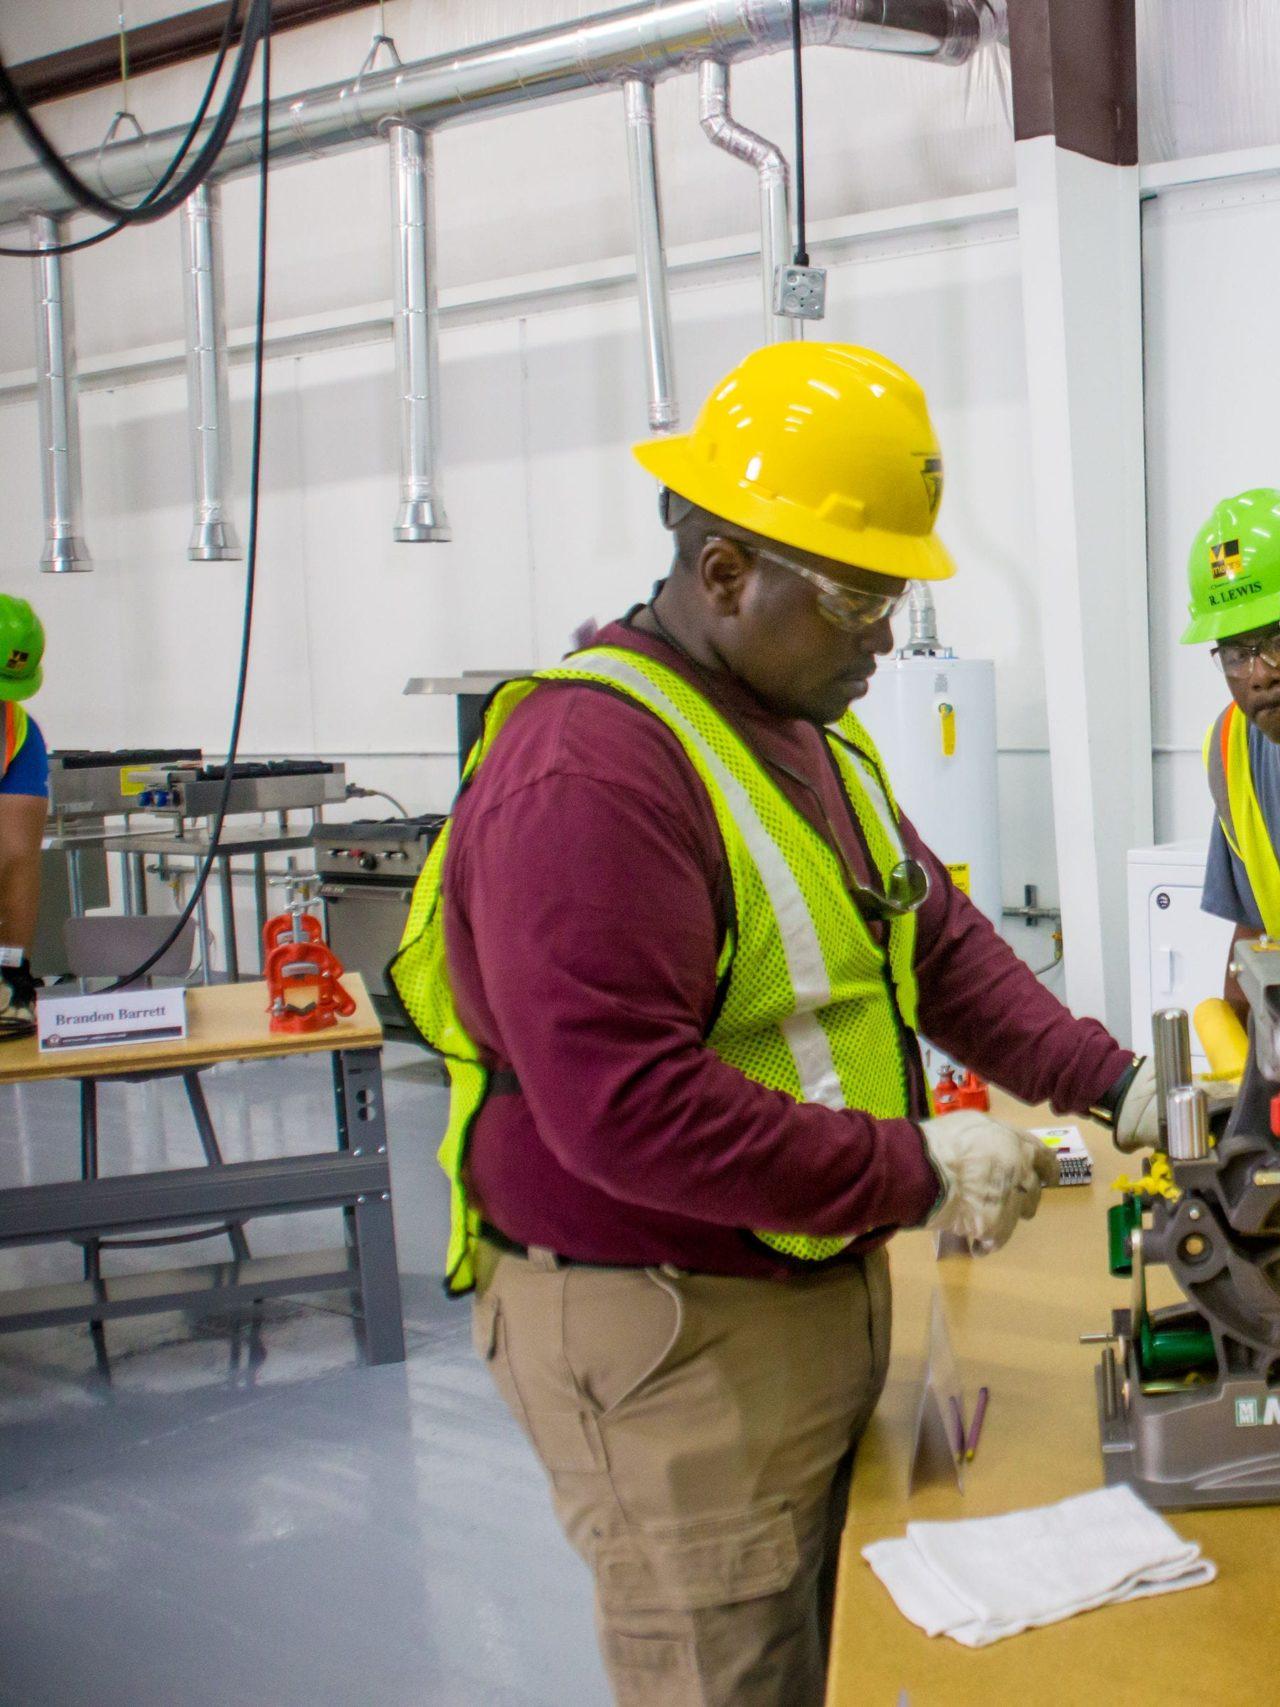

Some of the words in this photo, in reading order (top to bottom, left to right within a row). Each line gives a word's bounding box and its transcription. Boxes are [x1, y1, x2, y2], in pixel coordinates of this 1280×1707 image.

[1208, 595, 1220, 606] R.
[1220, 581, 1263, 603] LEWIS
[55, 1010, 115, 1026] Brandon
[118, 1005, 167, 1021] Barrett
